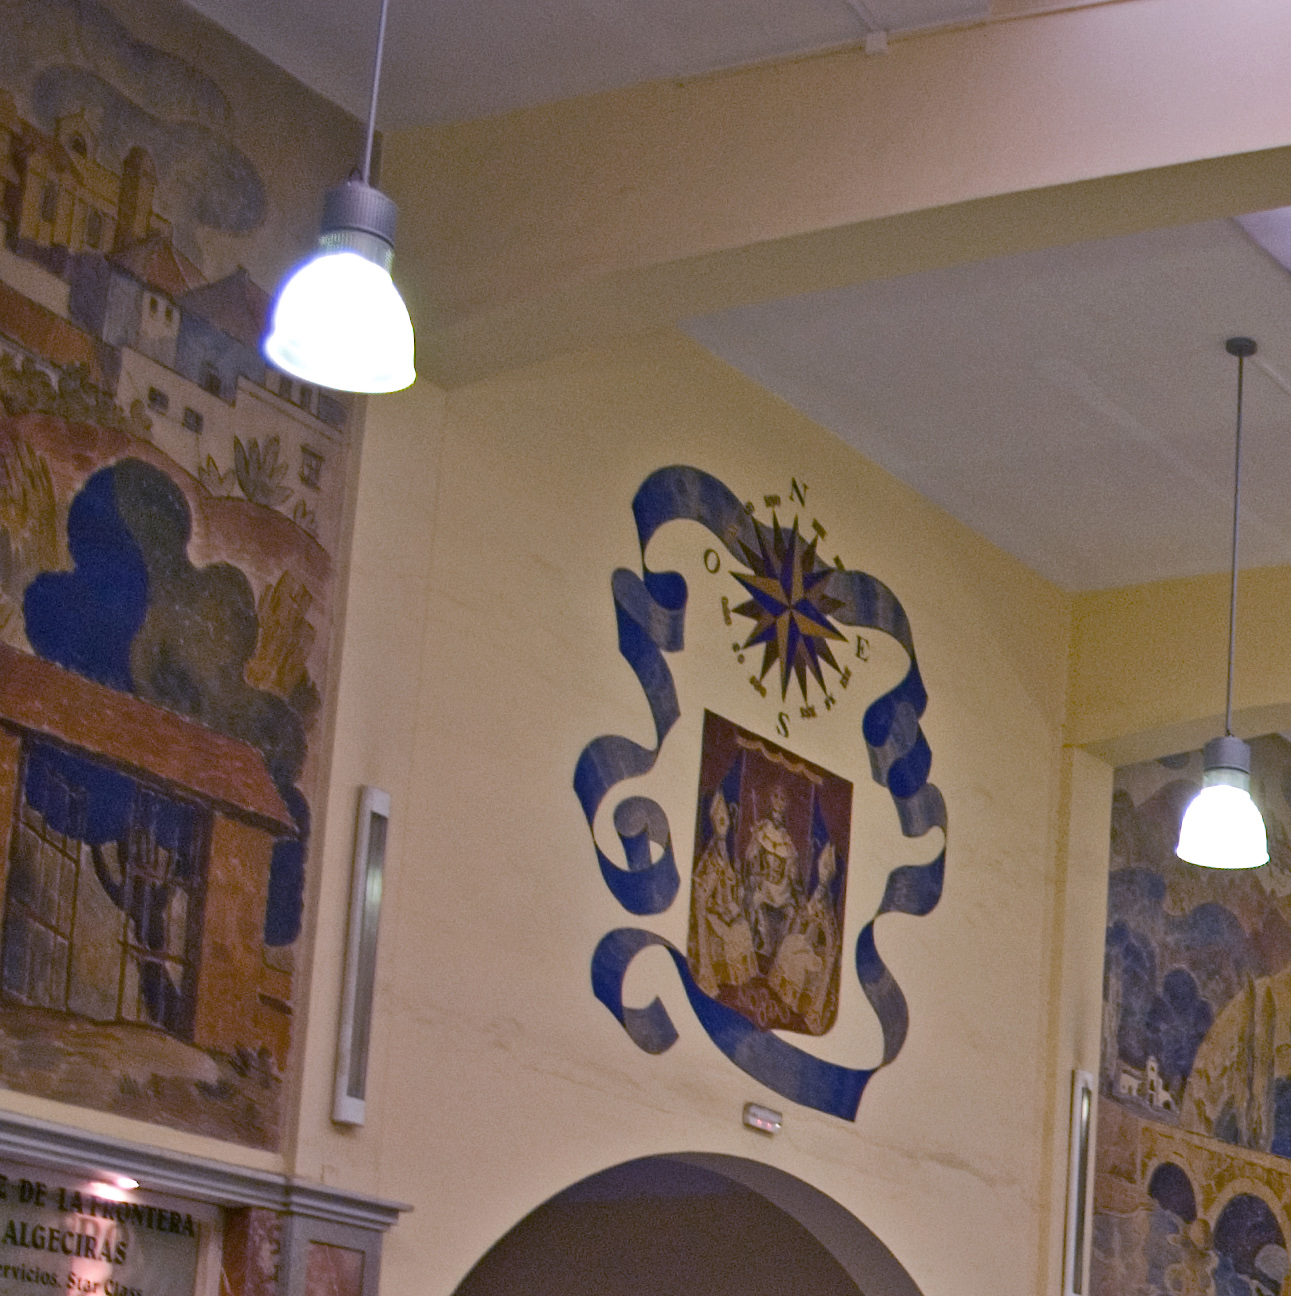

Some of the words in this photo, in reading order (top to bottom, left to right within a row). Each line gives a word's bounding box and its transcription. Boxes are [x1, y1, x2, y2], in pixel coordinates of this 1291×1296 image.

[788, 477, 809, 508] N
[704, 549, 720, 574] O
[855, 634, 870, 662] E
[776, 711, 790, 738] S
[20, 1178, 47, 1207] DE
[57, 1187, 84, 1214] LA
[89, 1195, 196, 1238] FRONTERA
[2, 1219, 129, 1265] ALGECIRAS
[66, 1270, 100, 1294] Star
